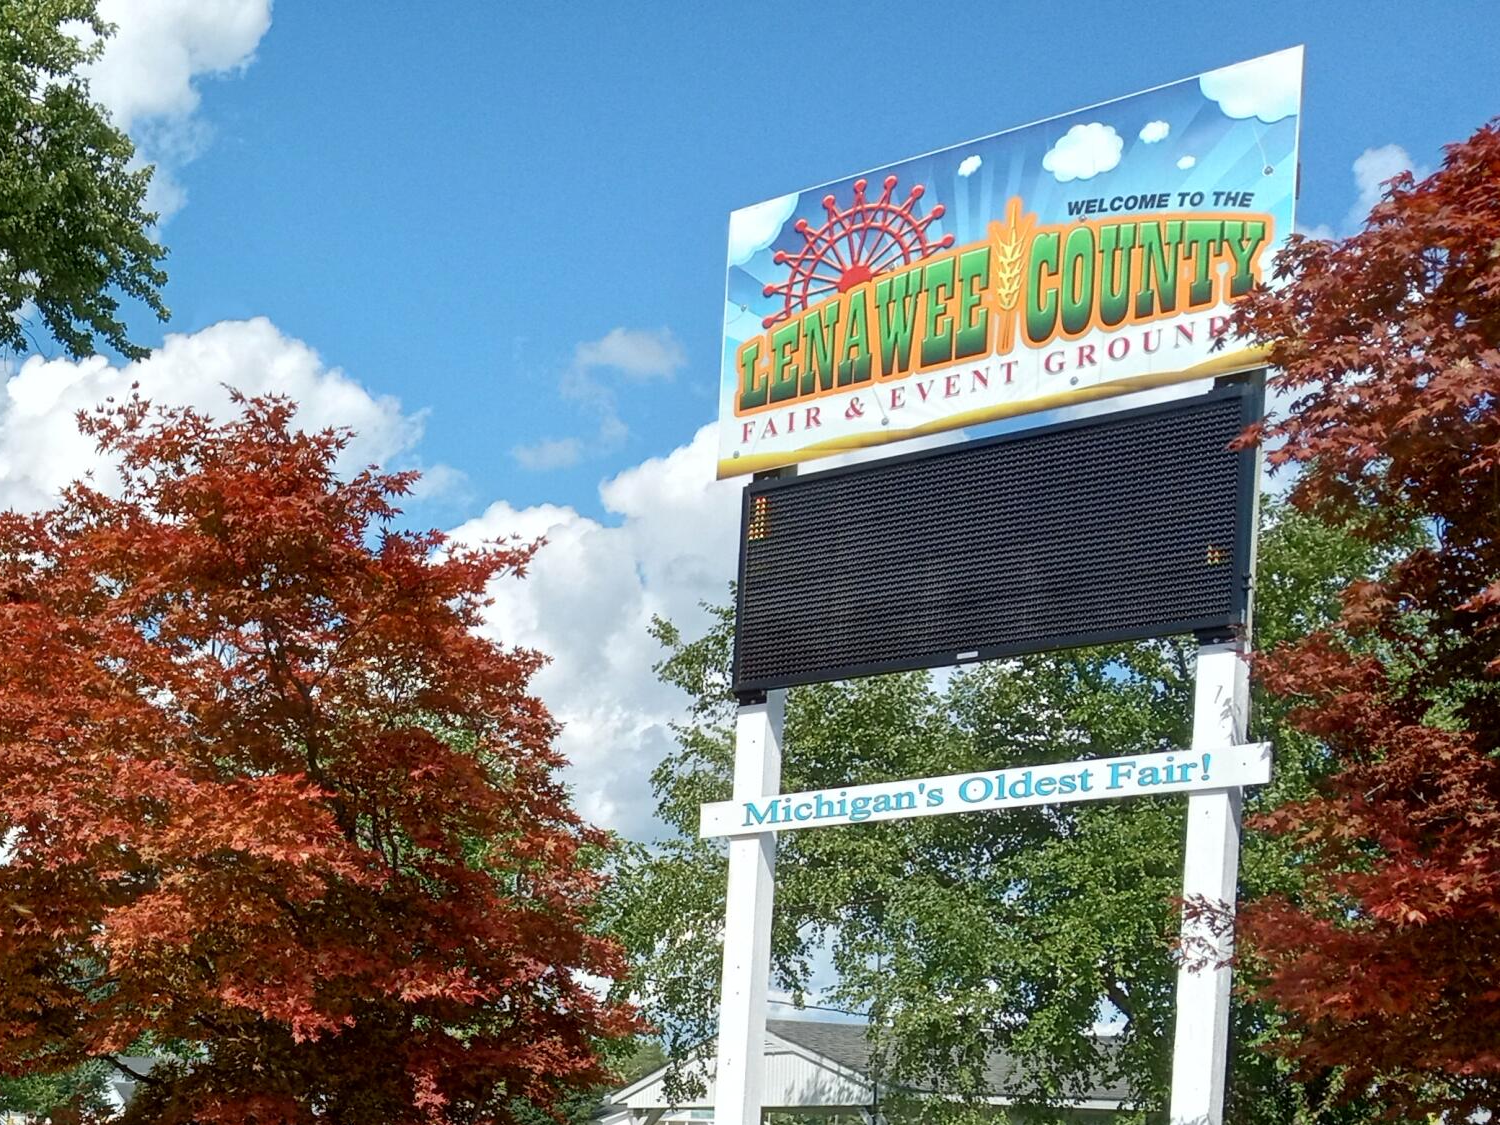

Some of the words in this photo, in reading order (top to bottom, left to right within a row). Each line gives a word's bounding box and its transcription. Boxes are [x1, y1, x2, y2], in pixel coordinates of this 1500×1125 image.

[1067, 193, 1171, 216] WELCOME
[1177, 192, 1205, 208] TO
[1213, 191, 1255, 208] THE
[738, 245, 992, 412] LENAWEE
[1026, 219, 1267, 343] COUNTY
[740, 406, 822, 444] FAIR
[844, 396, 865, 421] &
[888, 360, 1019, 411] EVENT
[1044, 315, 1234, 375] GROUND
[741, 782, 945, 827] Michigan's
[958, 768, 1094, 803] Oldest
[1105, 753, 1212, 790] Fair!
